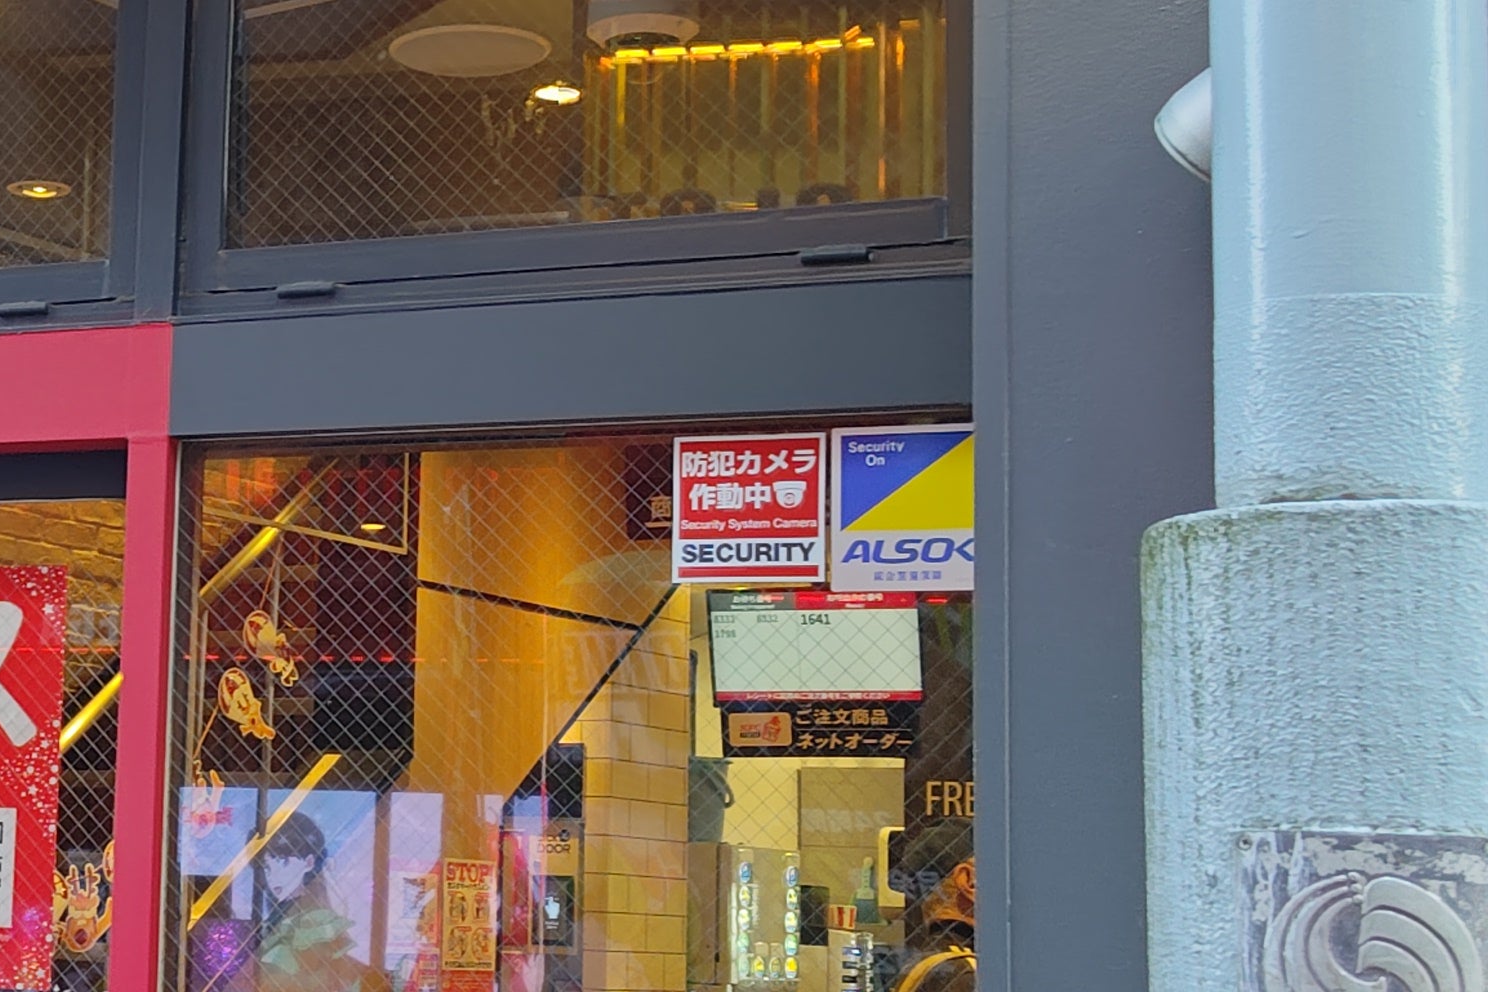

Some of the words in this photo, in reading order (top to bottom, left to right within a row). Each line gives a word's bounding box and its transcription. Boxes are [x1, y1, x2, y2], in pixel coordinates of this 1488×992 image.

[848, 441, 905, 453] Security
[681, 449, 817, 478] 防犯カメラ
[865, 454, 885, 466] On
[689, 482, 772, 511] 作動中
[680, 519, 726, 532] Security
[728, 518, 771, 531] System
[681, 542, 816, 563] SECURITY
[841, 537, 975, 564] ALSOK
[800, 613, 831, 626] 1641
[795, 708, 890, 726] ご注文商品
[796, 732, 913, 750] ネットオーダー
[446, 862, 490, 883] STOP
